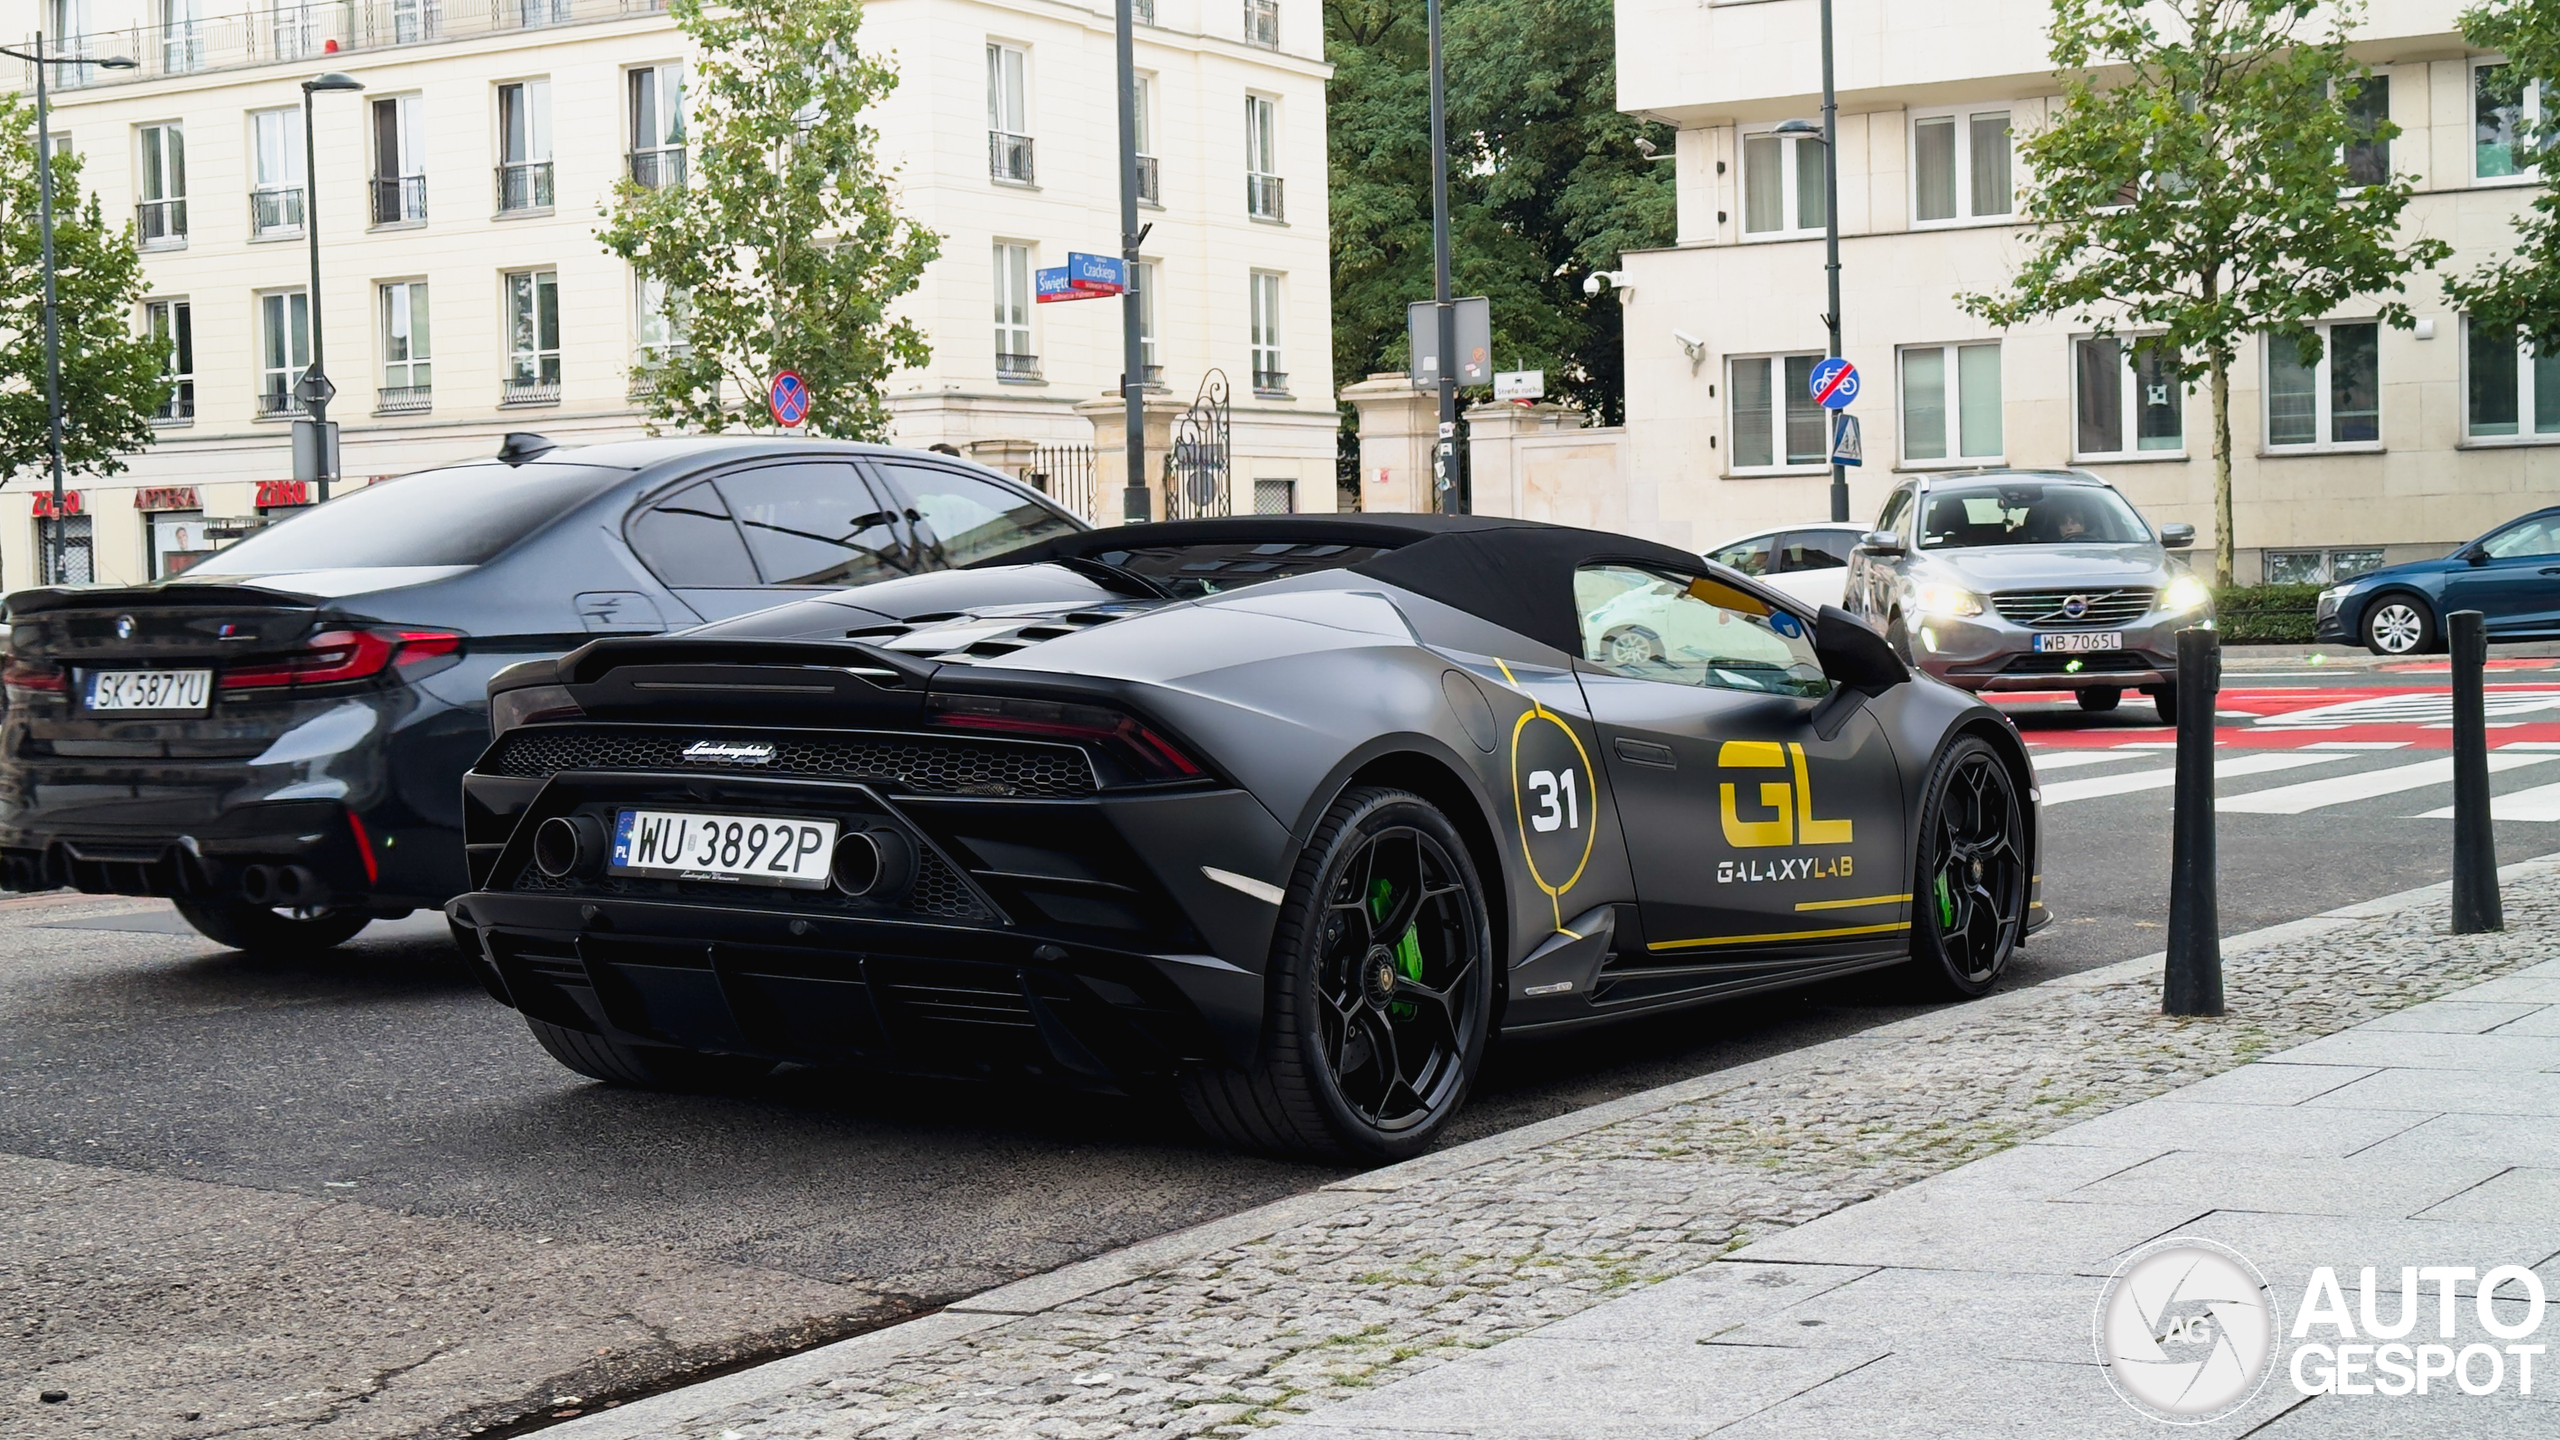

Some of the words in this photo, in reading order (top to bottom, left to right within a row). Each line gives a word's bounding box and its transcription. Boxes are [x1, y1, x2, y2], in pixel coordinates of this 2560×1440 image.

[1083, 262, 1116, 283] Czackiego
[1497, 387, 1519, 395] Strefa
[134, 487, 201, 508] APTEKA
[2044, 636, 2065, 650] WB
[2072, 634, 2120, 650] 7065L
[99, 675, 128, 707] SK
[133, 674, 206, 706] 587YU
[682, 740, 773, 759] Lamborghini
[1528, 768, 1579, 832] 31
[1718, 740, 1853, 848] GL
[615, 845, 628, 858] PL
[638, 817, 687, 864] WU
[697, 820, 823, 873] 3892P
